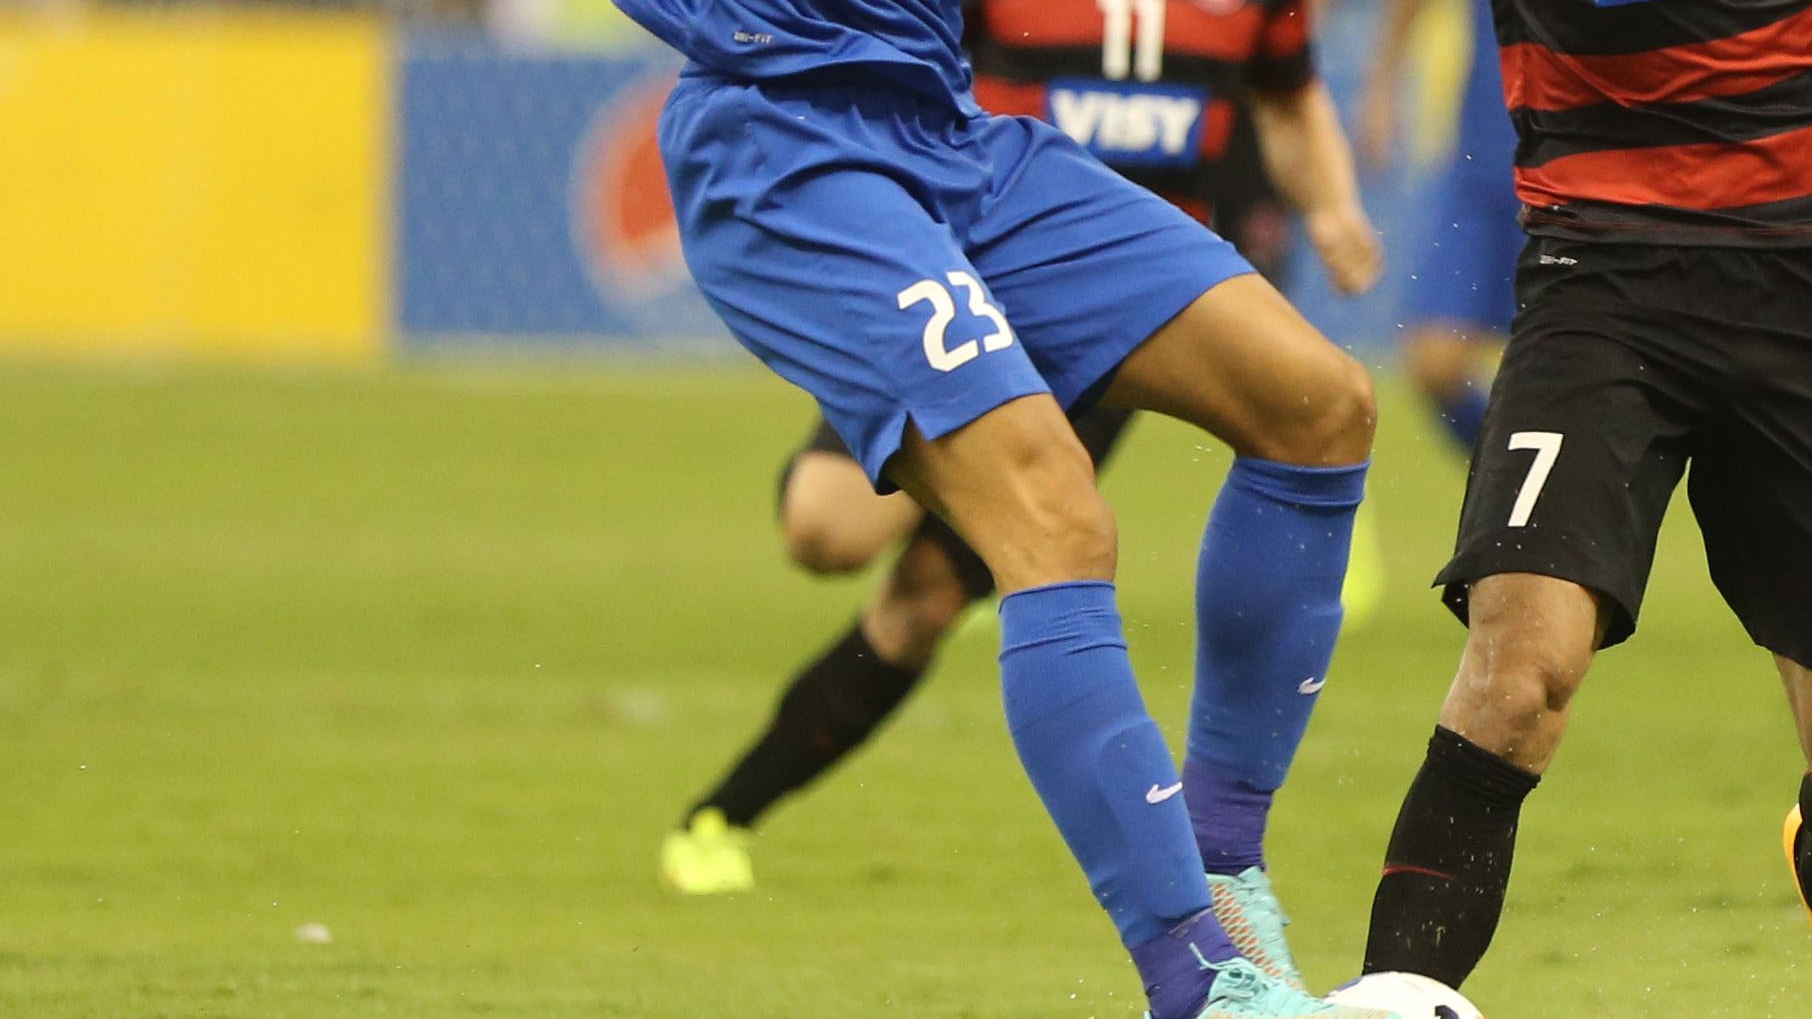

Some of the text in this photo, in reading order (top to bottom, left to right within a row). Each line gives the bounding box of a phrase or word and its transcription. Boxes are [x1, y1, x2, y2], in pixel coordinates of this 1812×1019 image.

[1051, 88, 1201, 156] VISY
[897, 271, 1014, 372] 23
[1507, 431, 1564, 527] 7
